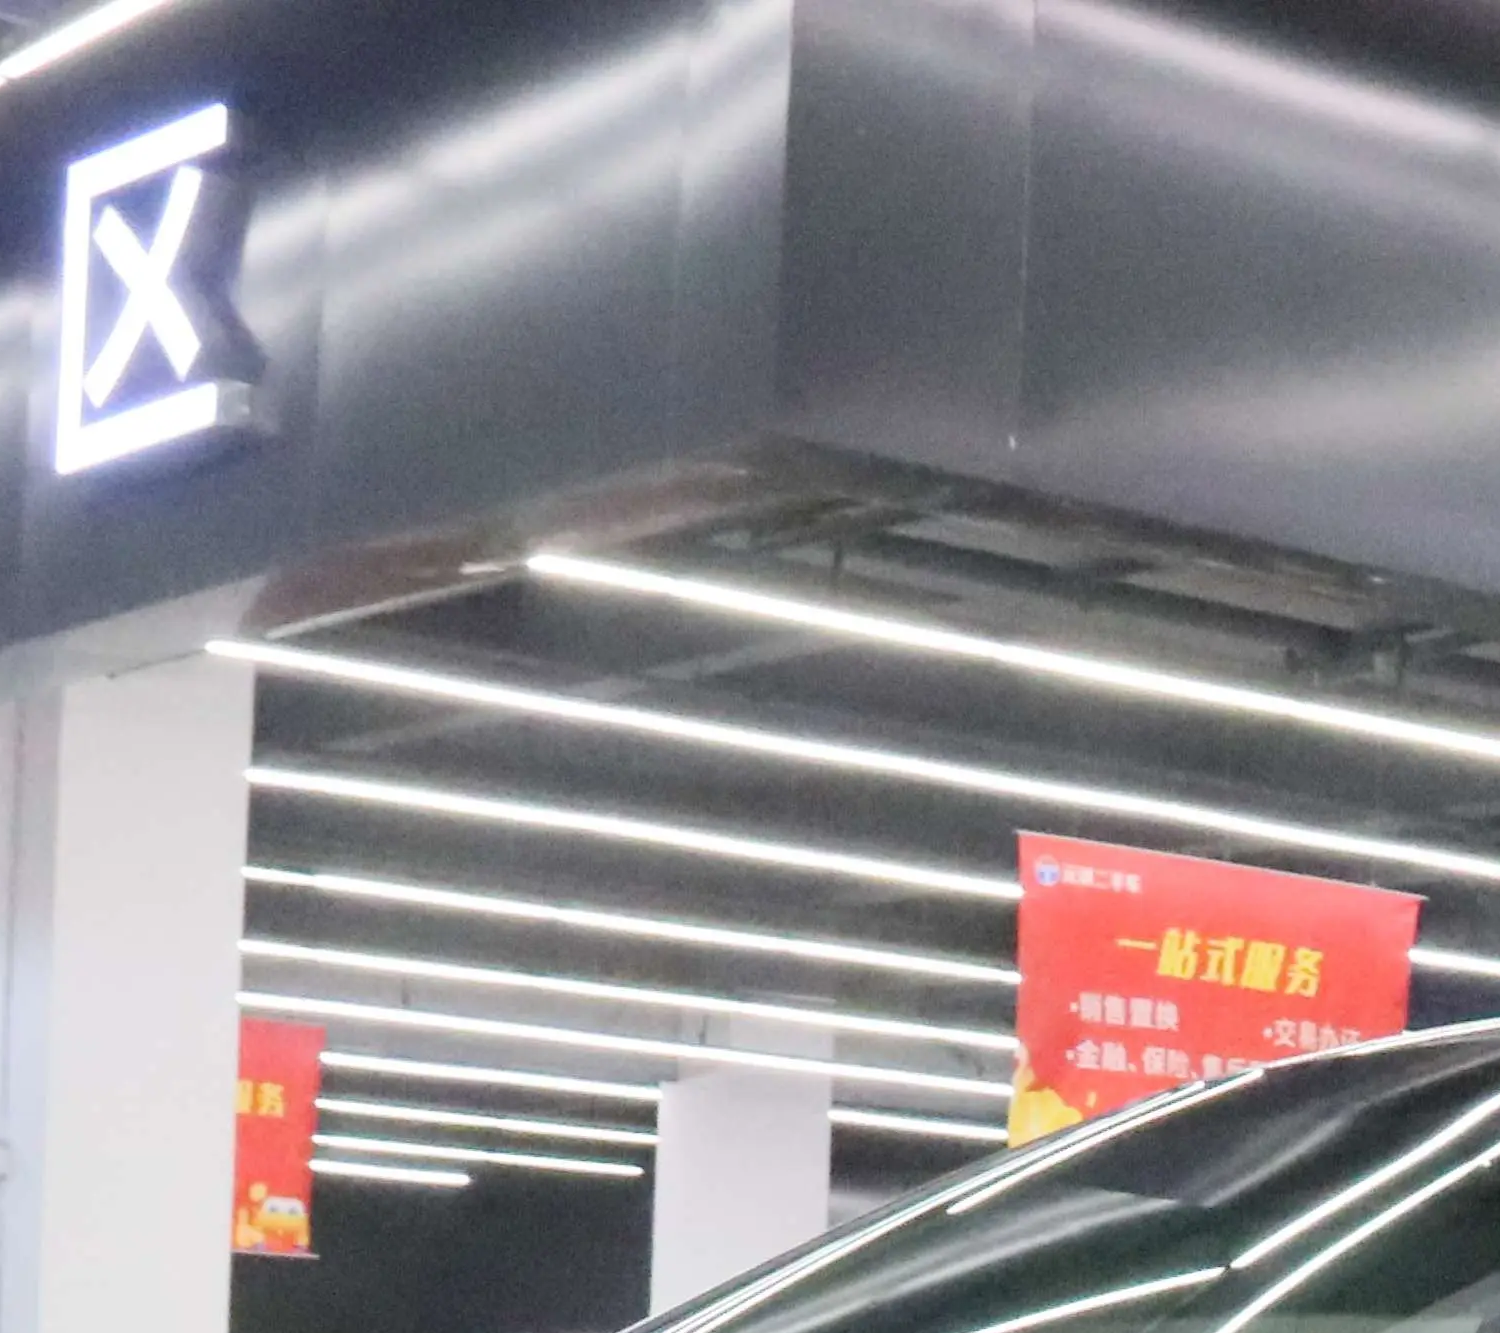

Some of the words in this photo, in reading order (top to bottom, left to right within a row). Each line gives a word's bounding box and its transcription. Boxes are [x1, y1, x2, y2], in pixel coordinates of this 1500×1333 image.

[1116, 927, 1325, 998] 一站式服务
